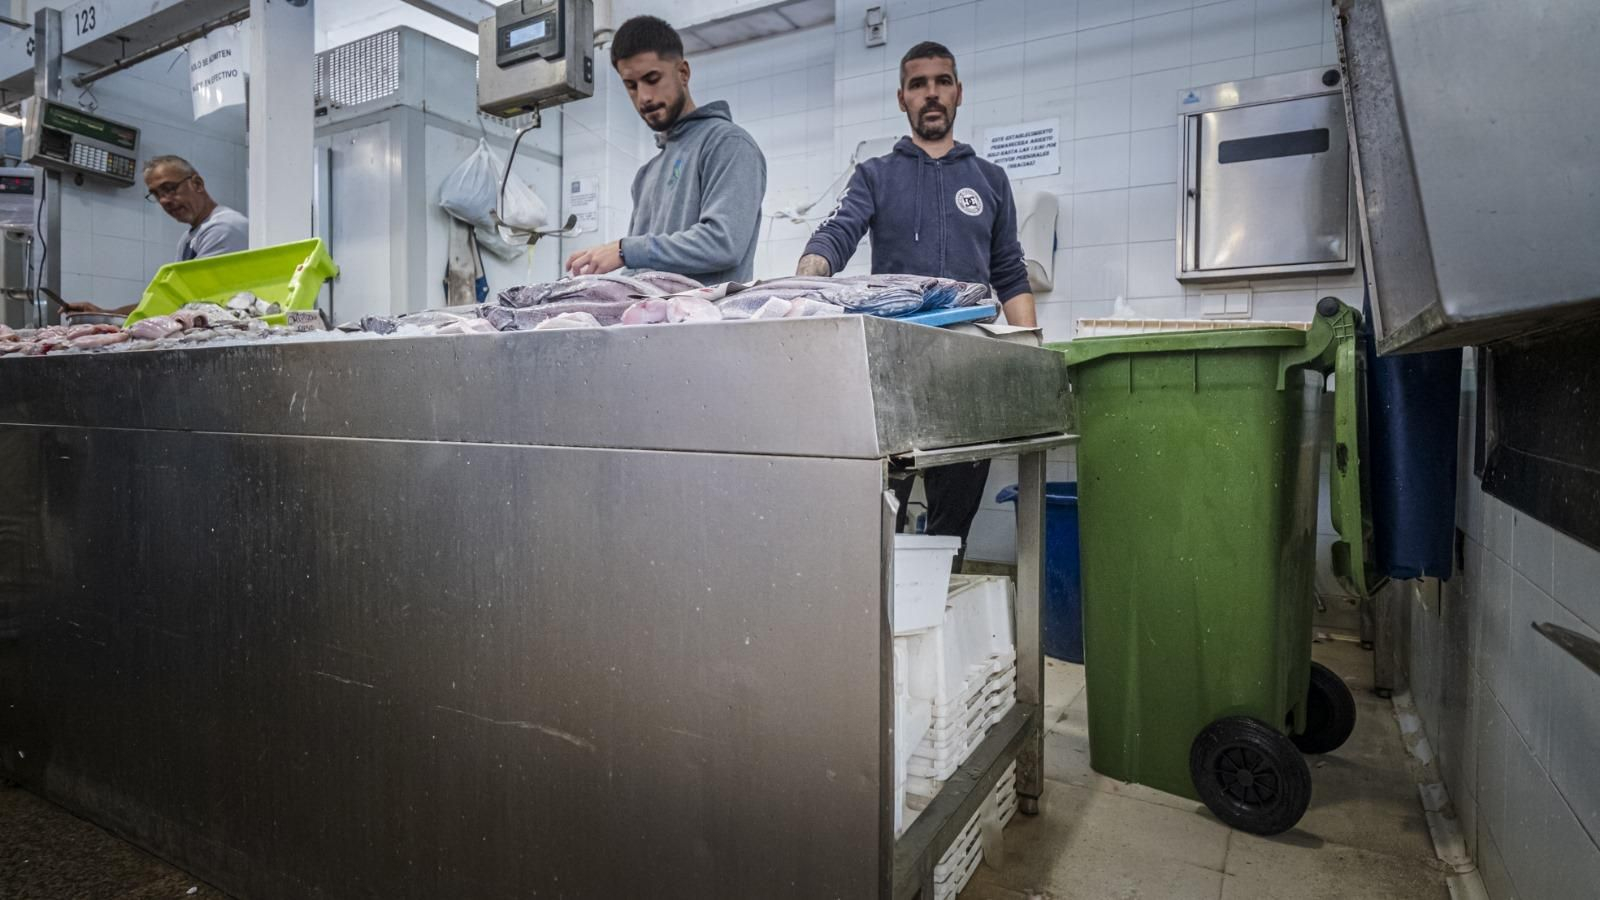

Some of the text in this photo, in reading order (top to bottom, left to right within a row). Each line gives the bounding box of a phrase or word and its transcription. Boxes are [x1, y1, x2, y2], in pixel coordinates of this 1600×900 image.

[75, 6, 96, 36] 123
[211, 69, 238, 84] EFECTIVO
[1030, 136, 1053, 144] ABIERTO
